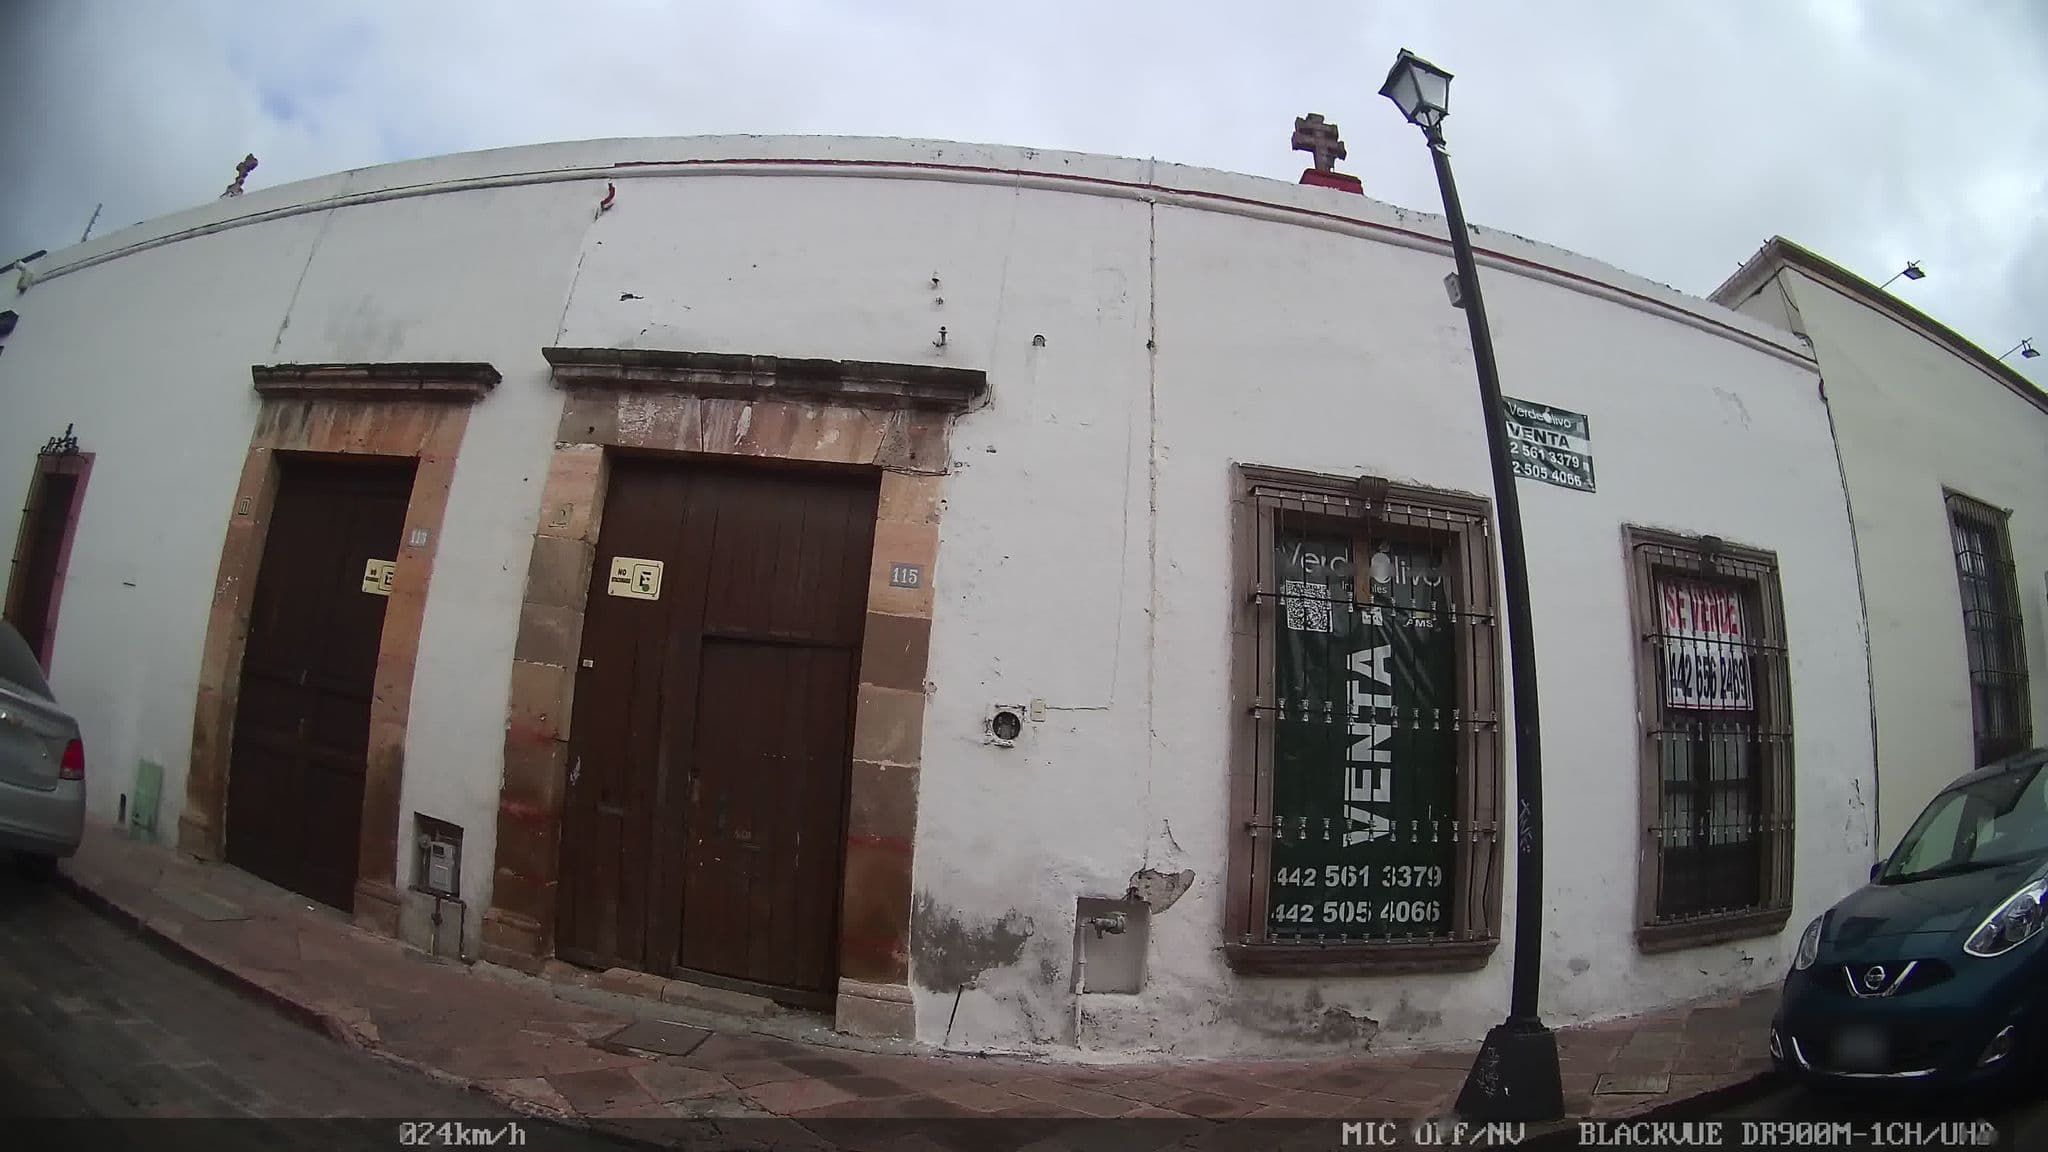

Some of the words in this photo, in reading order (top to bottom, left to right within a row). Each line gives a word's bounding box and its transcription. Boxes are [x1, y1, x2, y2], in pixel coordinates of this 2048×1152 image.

[1508, 422, 1570, 449] VENTA
[1522, 444, 1545, 460] 561
[1548, 451, 1580, 468] 3379
[1524, 463, 1548, 479] 505
[1551, 470, 1582, 487] 4066
[618, 568, 627, 576] NO
[892, 567, 918, 584] 115
[1663, 584, 1687, 630] SE
[1690, 588, 1738, 635] VENDE
[1669, 652, 1693, 698] 442
[1695, 655, 1717, 700] 656
[1719, 656, 1748, 701] 2469
[1343, 644, 1392, 848] VENTA
[1275, 867, 1317, 887] 442
[1325, 865, 1370, 887] 561
[1382, 865, 1442, 888] 3379
[1271, 903, 1315, 923] 442
[1322, 901, 1372, 923] 505
[1380, 900, 1440, 923] 4066
